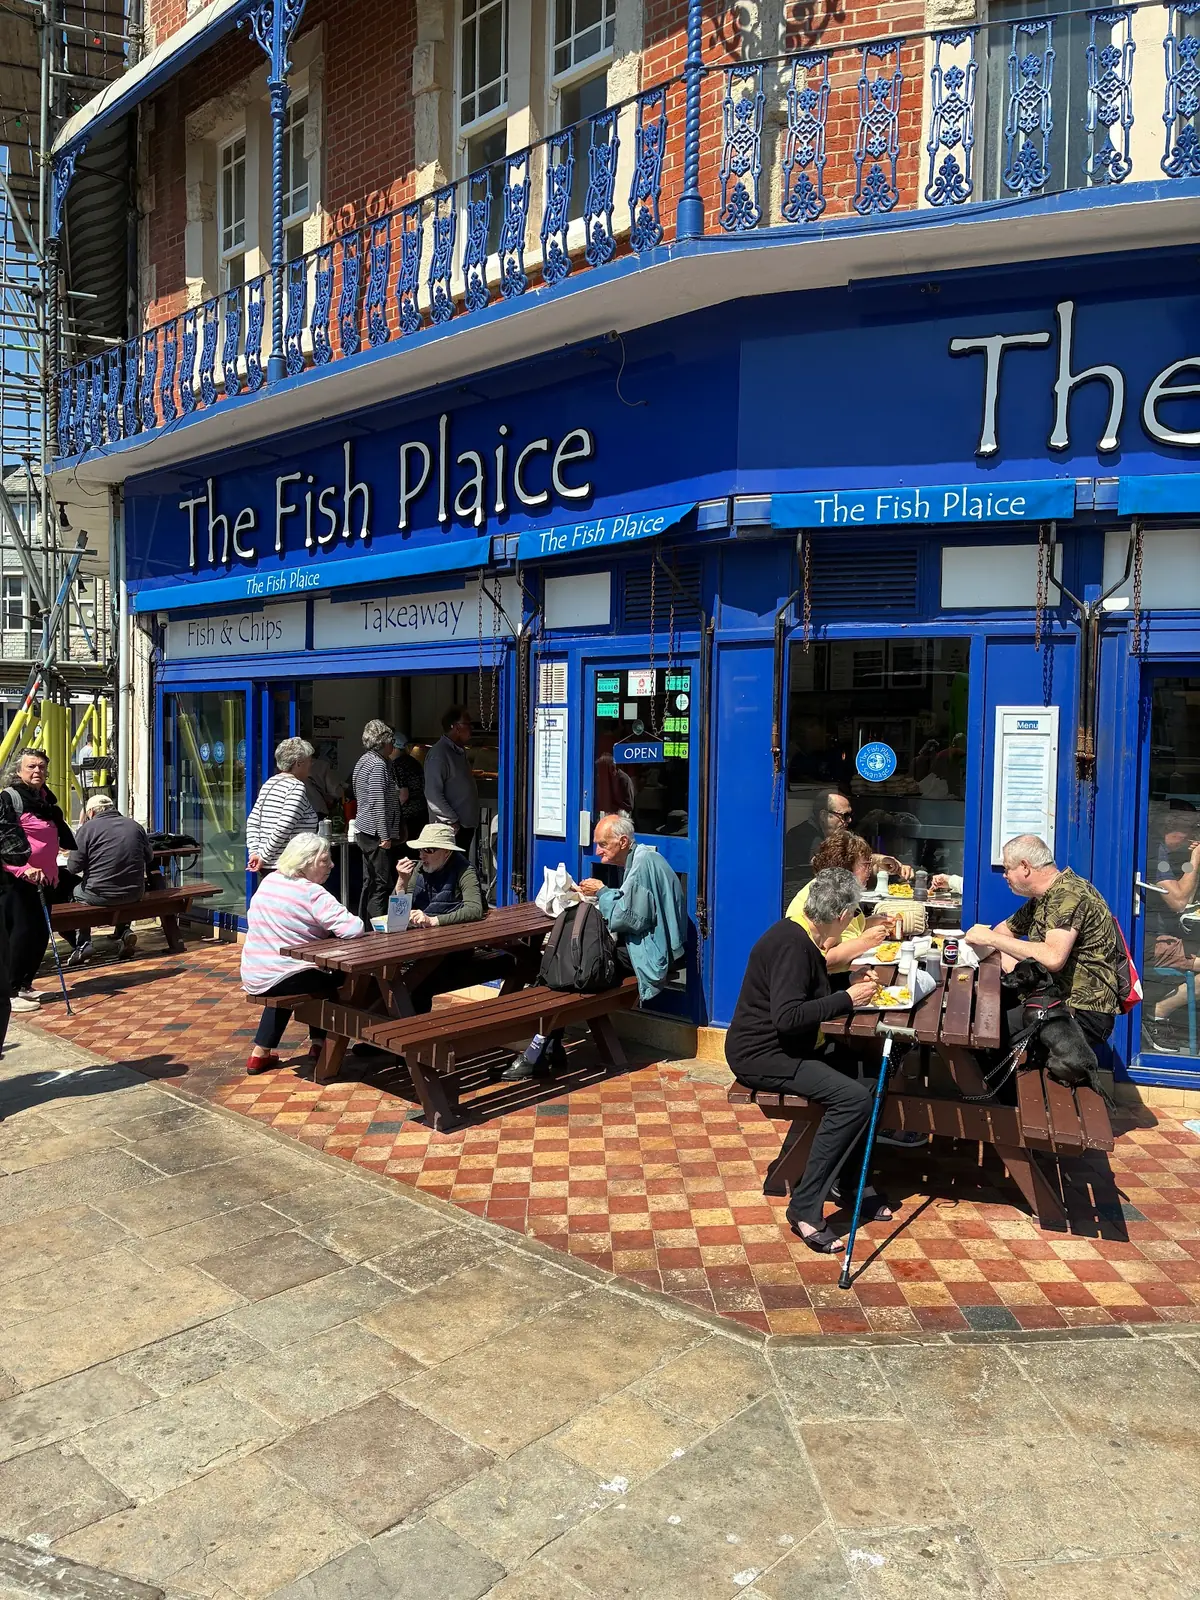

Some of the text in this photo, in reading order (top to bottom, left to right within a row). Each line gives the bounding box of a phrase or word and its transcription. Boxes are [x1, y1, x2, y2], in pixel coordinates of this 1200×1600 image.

[950, 300, 1200, 453] The
[178, 413, 593, 567] The Fish Plaice
[814, 487, 1026, 524] The Fish Plaice
[539, 514, 665, 553] The Fish Plaice
[246, 568, 320, 595] The Fish Plaice
[187, 612, 283, 650] Fish & Chips
[360, 597, 464, 635] Takeaway
[1017, 720, 1039, 730] Menu
[623, 747, 658, 760] OPEN
[861, 767, 890, 779] Swanage
